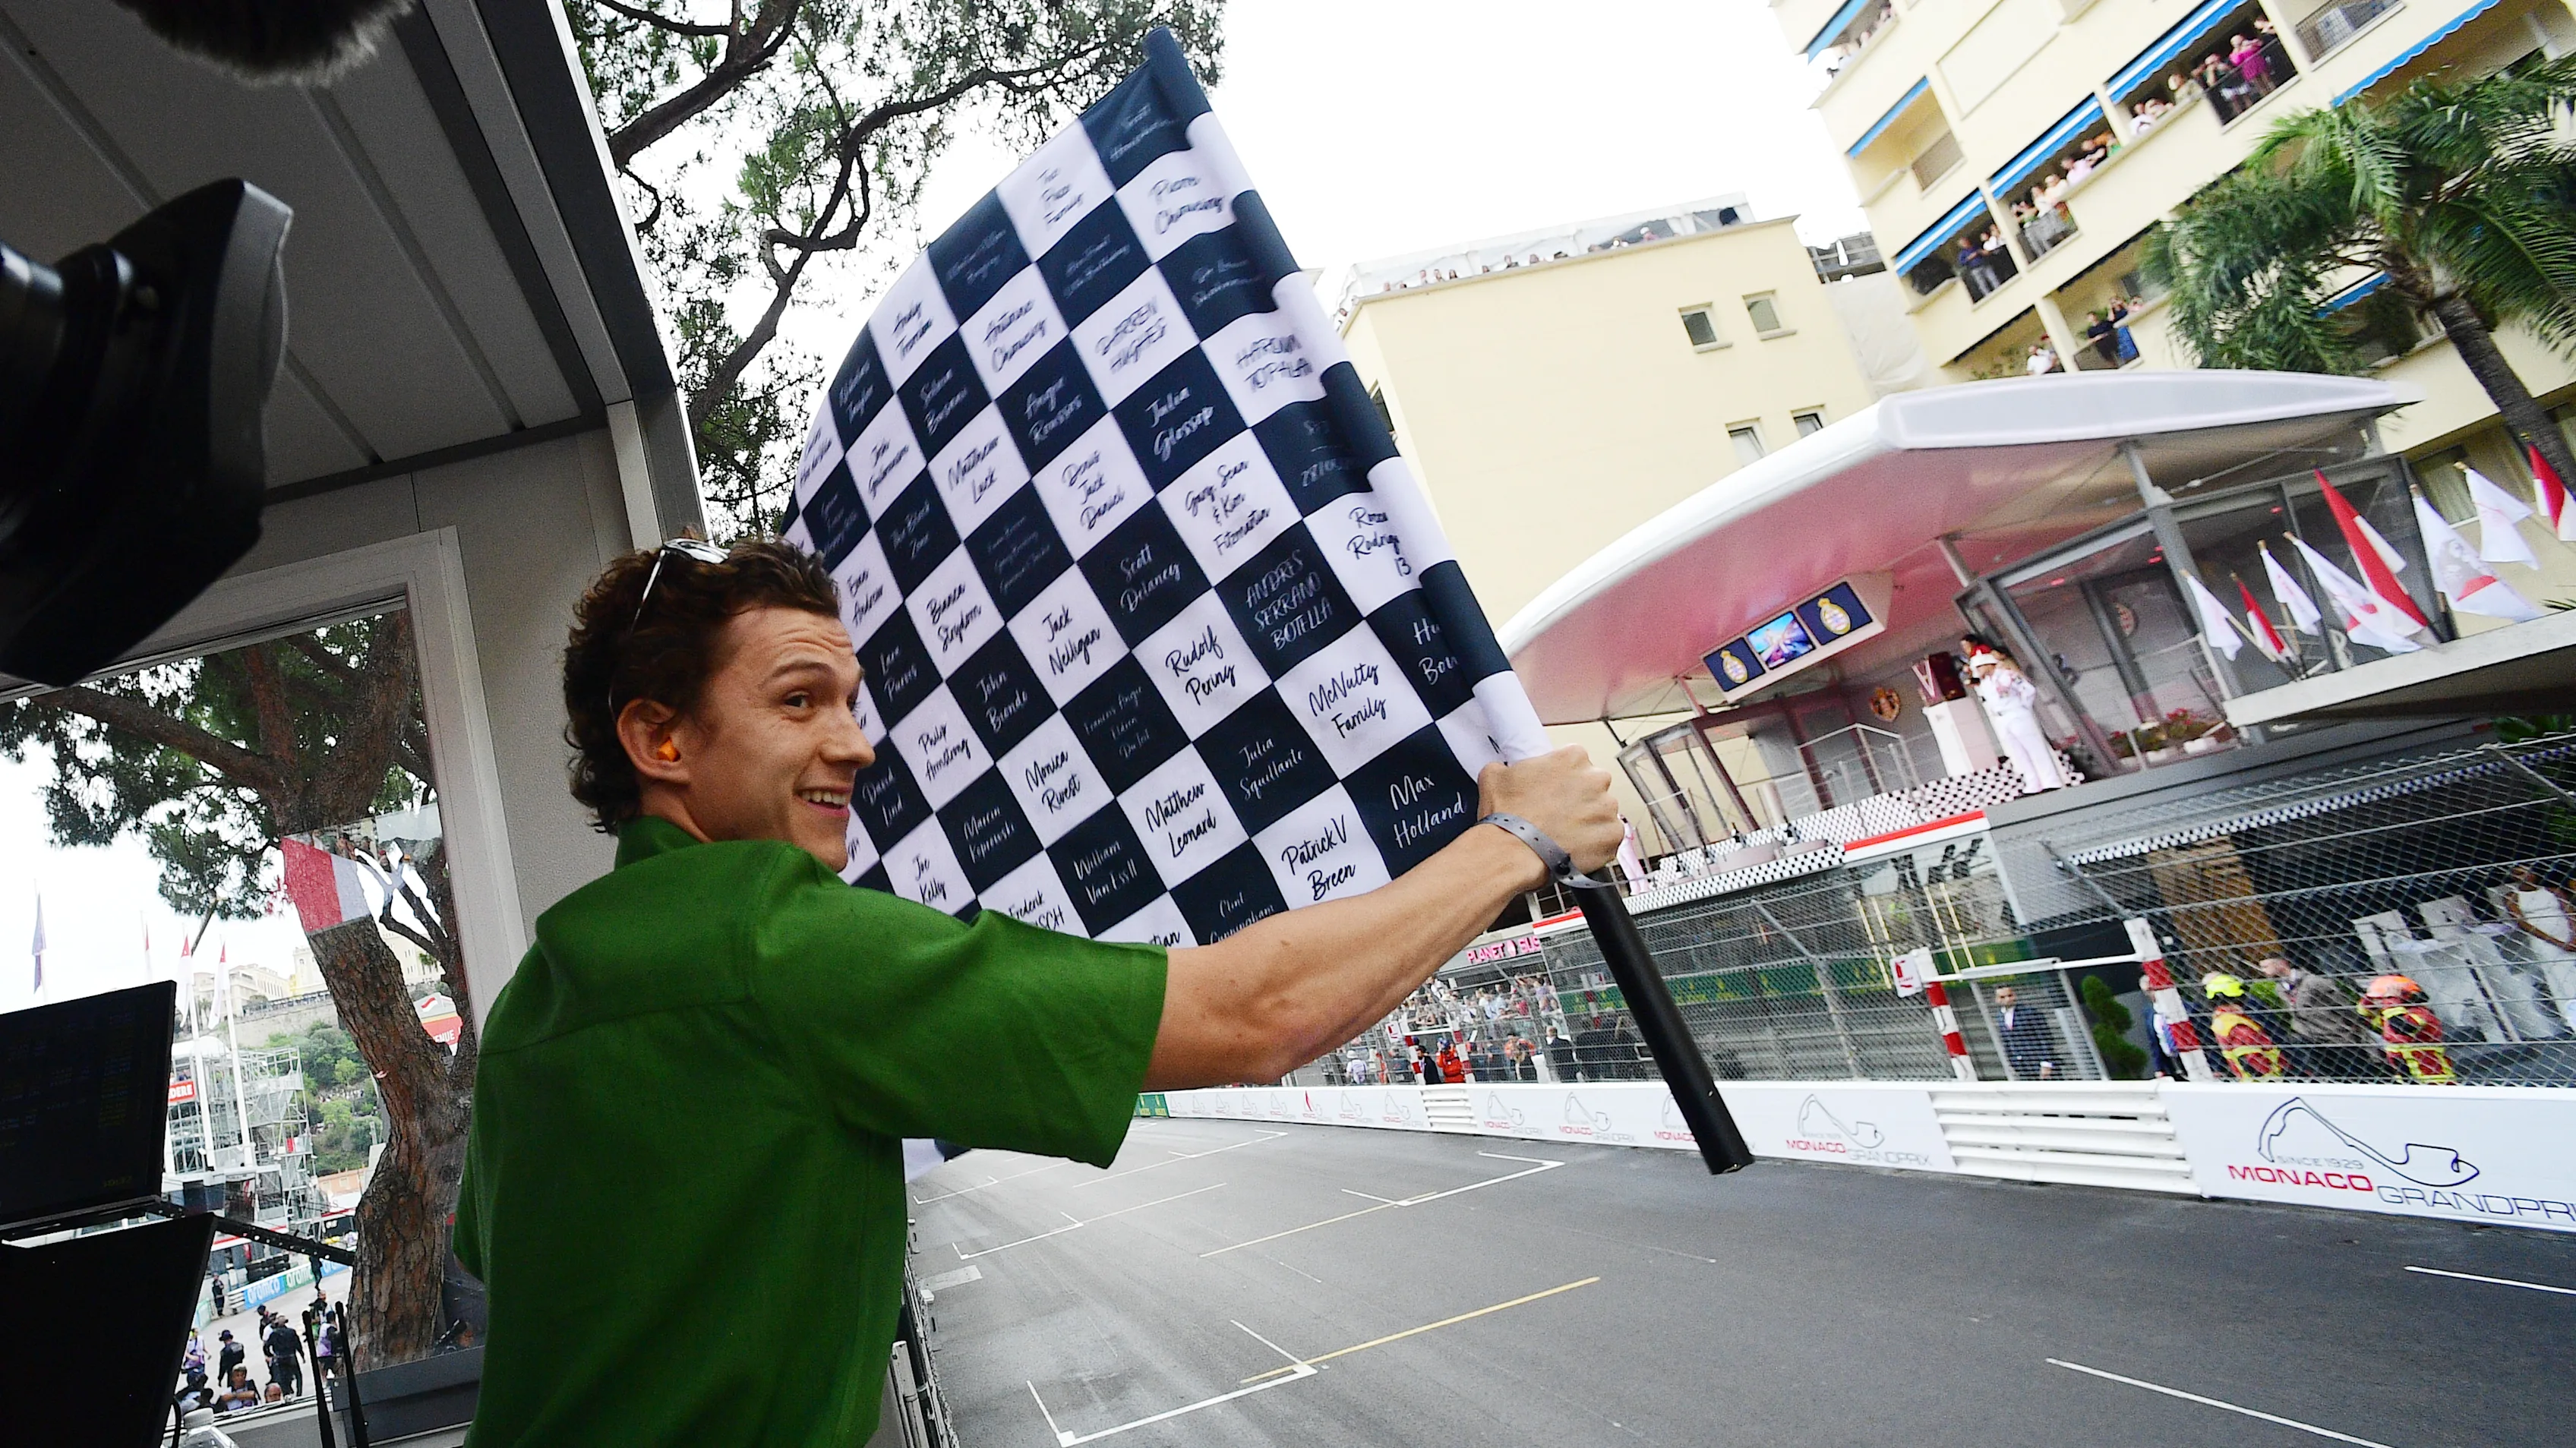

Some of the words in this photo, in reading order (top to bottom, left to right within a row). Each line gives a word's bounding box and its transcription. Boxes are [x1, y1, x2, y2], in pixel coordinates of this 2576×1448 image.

[1145, 386, 1192, 428] Julia
[1153, 405, 1215, 462] Glossop
[1120, 543, 1153, 582] Scott
[1394, 557, 1413, 577] 13
[1254, 571, 1322, 633] SERRANO
[1042, 605, 1073, 643] Jack
[1270, 596, 1334, 651] BOTELLA
[1049, 628, 1100, 676] Nelligan
[1165, 624, 1223, 677] Rudolf
[1185, 664, 1236, 706] Pering
[1309, 662, 1379, 717] McNulty
[918, 723, 948, 755] Philip
[1331, 697, 1387, 739] Family
[1024, 750, 1069, 793] Monica
[1239, 737, 1274, 768] Julia
[1145, 782, 1206, 833] Matthew
[1389, 773, 1435, 812] Max
[1168, 808, 1217, 858] Leonard
[1392, 791, 1467, 850] Holland
[1281, 826, 1337, 875] Patrick
[1331, 814, 1347, 844] V
[912, 853, 930, 882] Joe
[1308, 863, 1356, 902] Breen
[1466, 942, 1505, 964] PLANET
[1786, 1140, 1846, 1153] MONACO
[2325, 1156, 2365, 1171] 1929
[2227, 1164, 2375, 1193] MONACO
[247, 1276, 282, 1305] aramco
